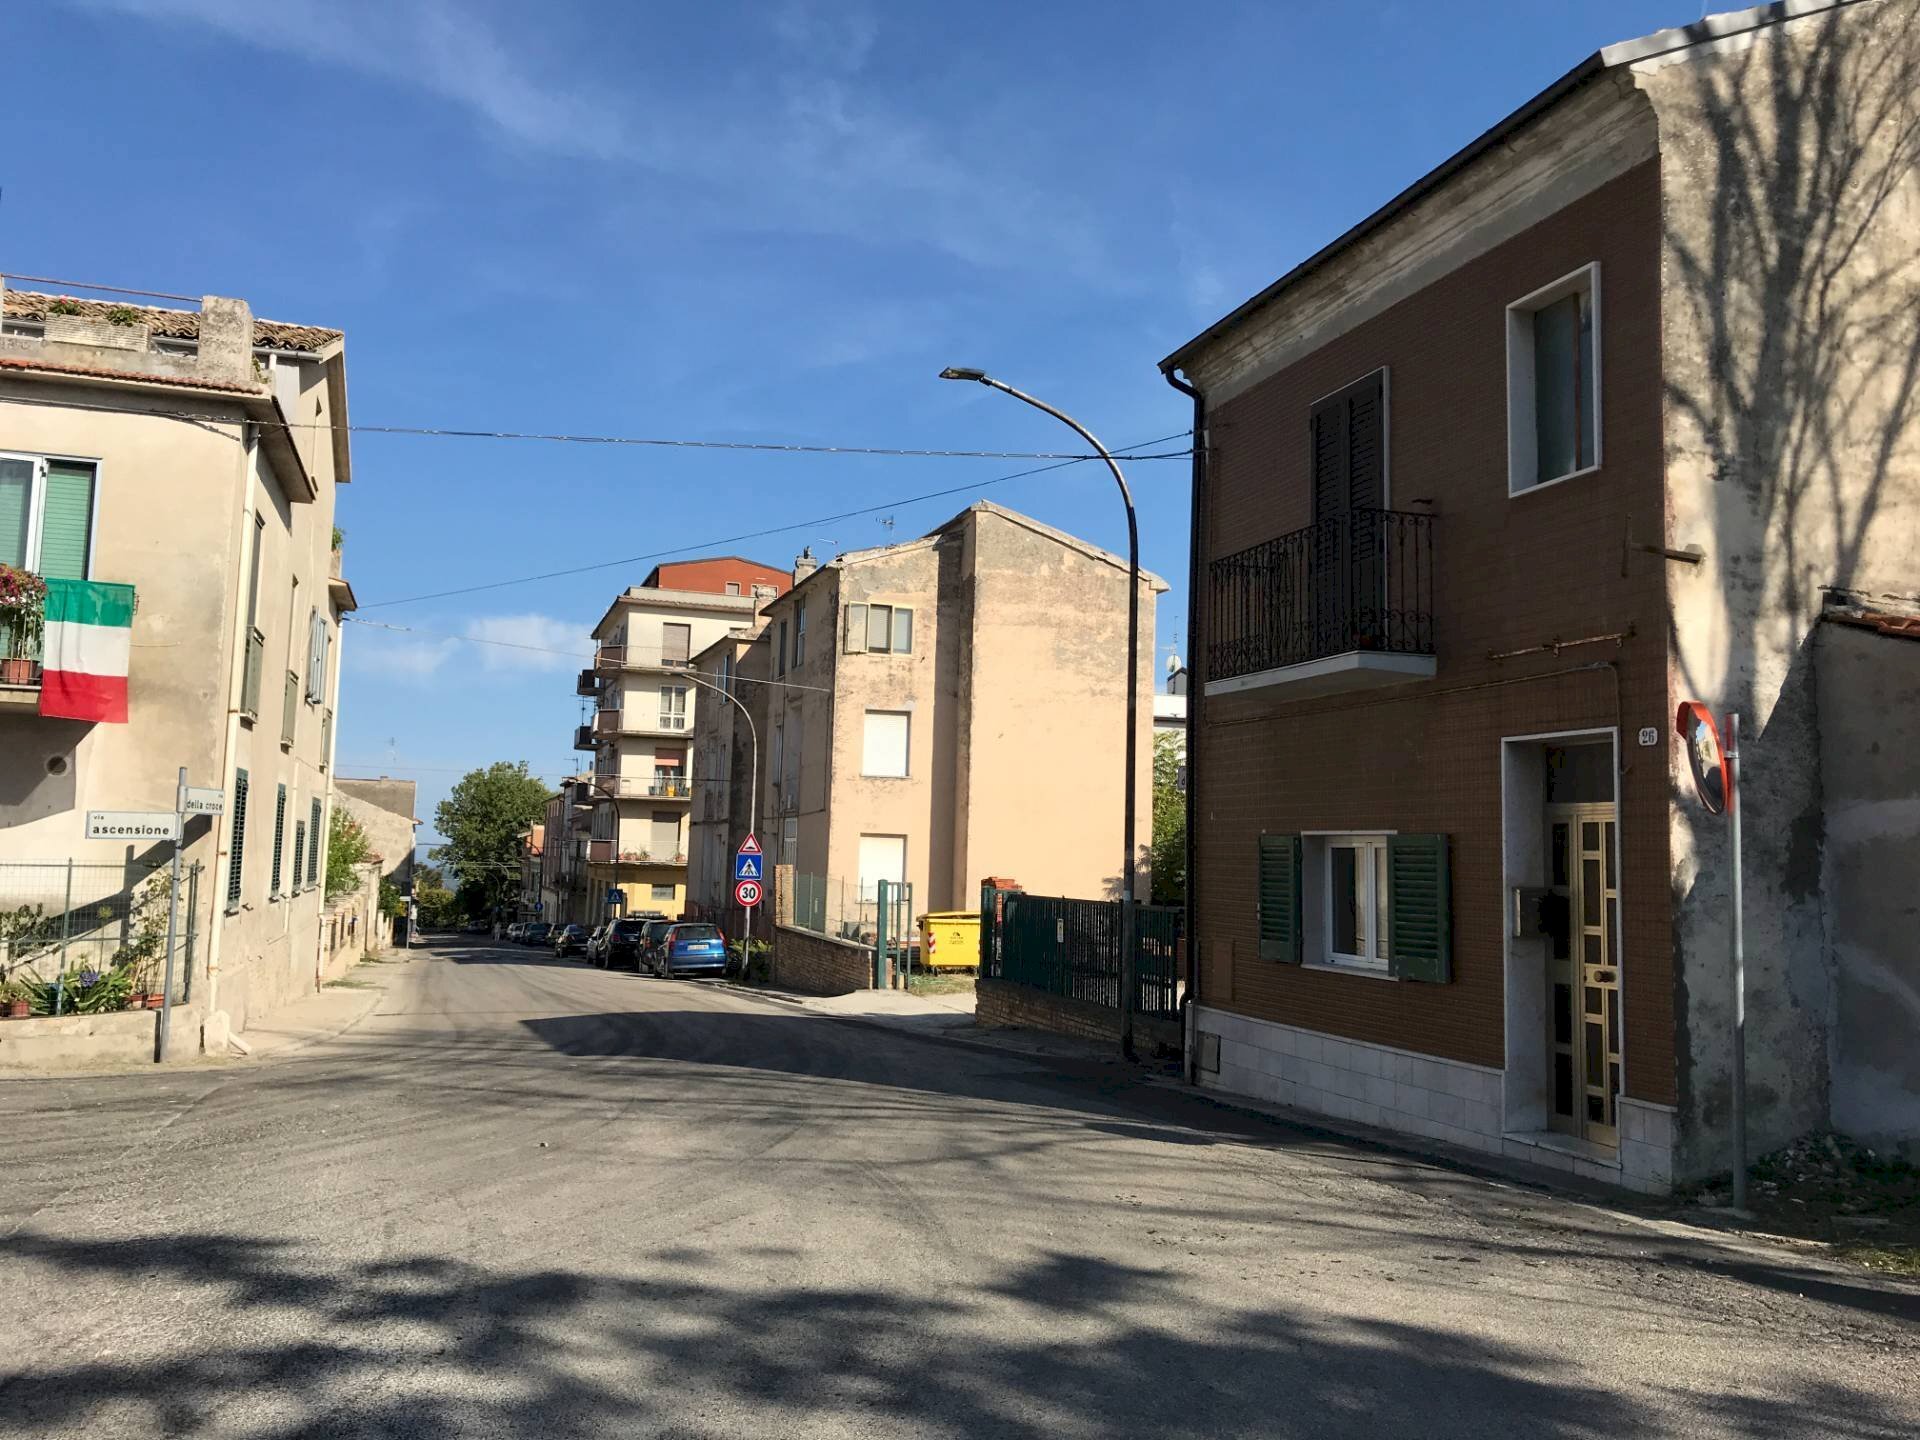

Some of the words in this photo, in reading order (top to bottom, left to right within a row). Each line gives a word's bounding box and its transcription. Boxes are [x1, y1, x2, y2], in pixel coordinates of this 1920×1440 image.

[1642, 730, 1655, 744] 26
[186, 799, 203, 810] della
[205, 802, 223, 811] croce
[93, 825, 169, 835] ascensione
[742, 887, 756, 899] 30
